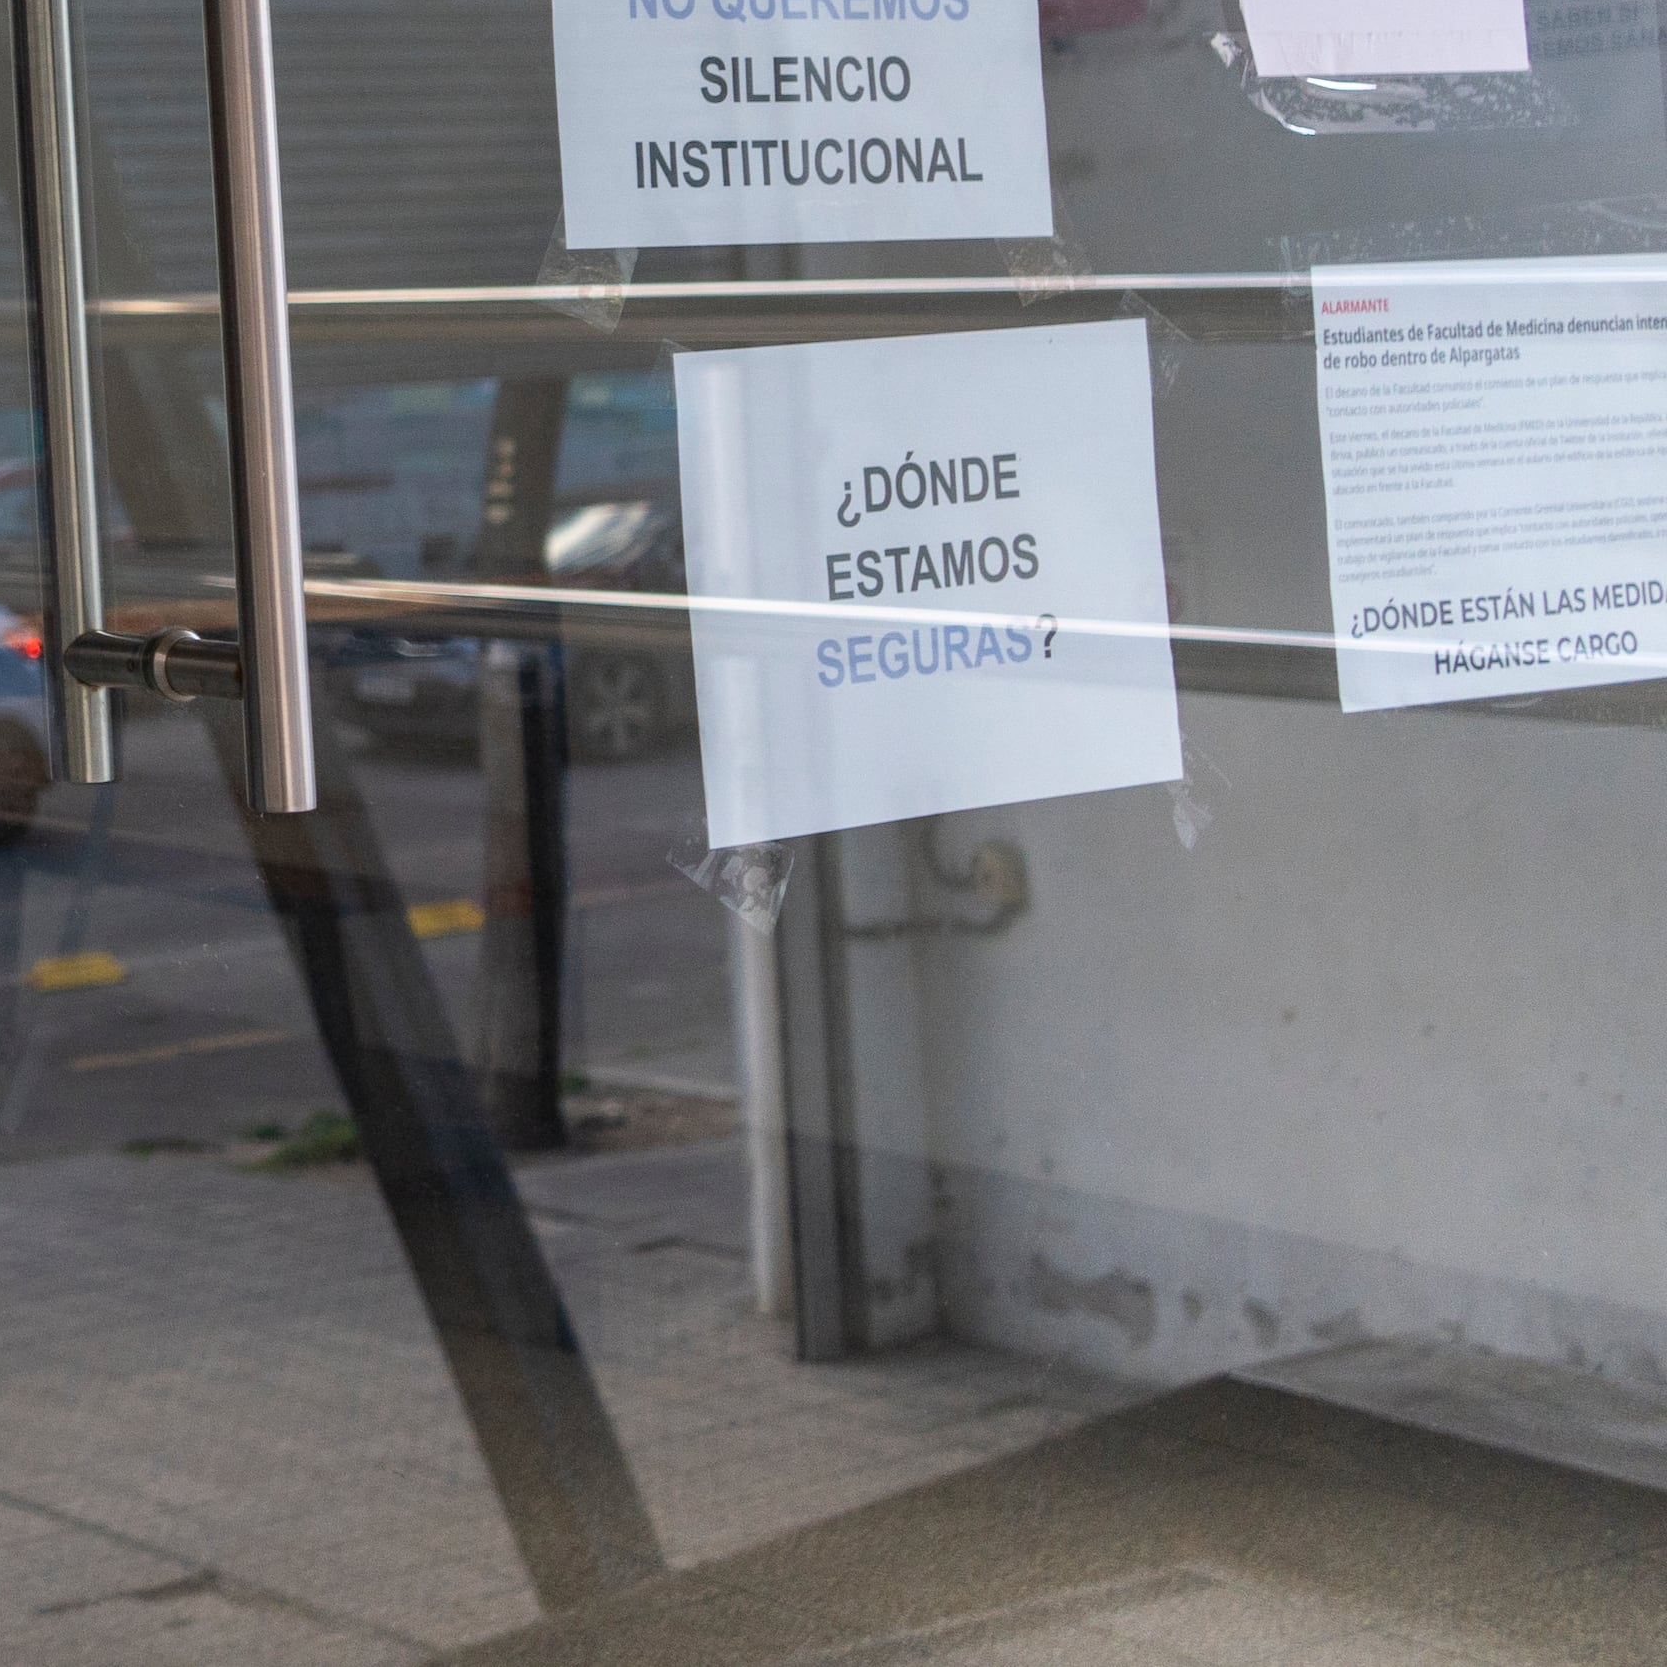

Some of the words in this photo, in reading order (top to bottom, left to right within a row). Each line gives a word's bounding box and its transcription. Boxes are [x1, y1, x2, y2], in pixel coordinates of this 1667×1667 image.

[699, 55, 911, 104] SILENCIO
[634, 136, 984, 189] INSTITUCIONAL
[1321, 298, 1389, 315] ALARMANTE
[1323, 324, 1405, 346] Estudiantes
[1408, 323, 1425, 342] de
[1427, 319, 1484, 340] Facultad
[1486, 319, 1503, 338] de
[1505, 316, 1564, 336] Medicina
[1567, 314, 1634, 334] denuncian
[1323, 353, 1342, 370] de
[1345, 350, 1378, 369] robo
[1381, 347, 1427, 366] dentro
[1430, 347, 1447, 364] de
[1449, 345, 1521, 367] Alpargatas
[837, 450, 1021, 529] ¿DÓNDE
[826, 533, 1040, 601] ESTAMOS
[1351, 598, 1454, 639] ¿DÓNDE
[1460, 587, 1537, 623] ESTÁN
[1543, 587, 1587, 616] LAS
[816, 613, 1059, 688] SEGURAS?
[1434, 638, 1551, 675] HÁGANSE
[1557, 630, 1638, 663] CARGO
